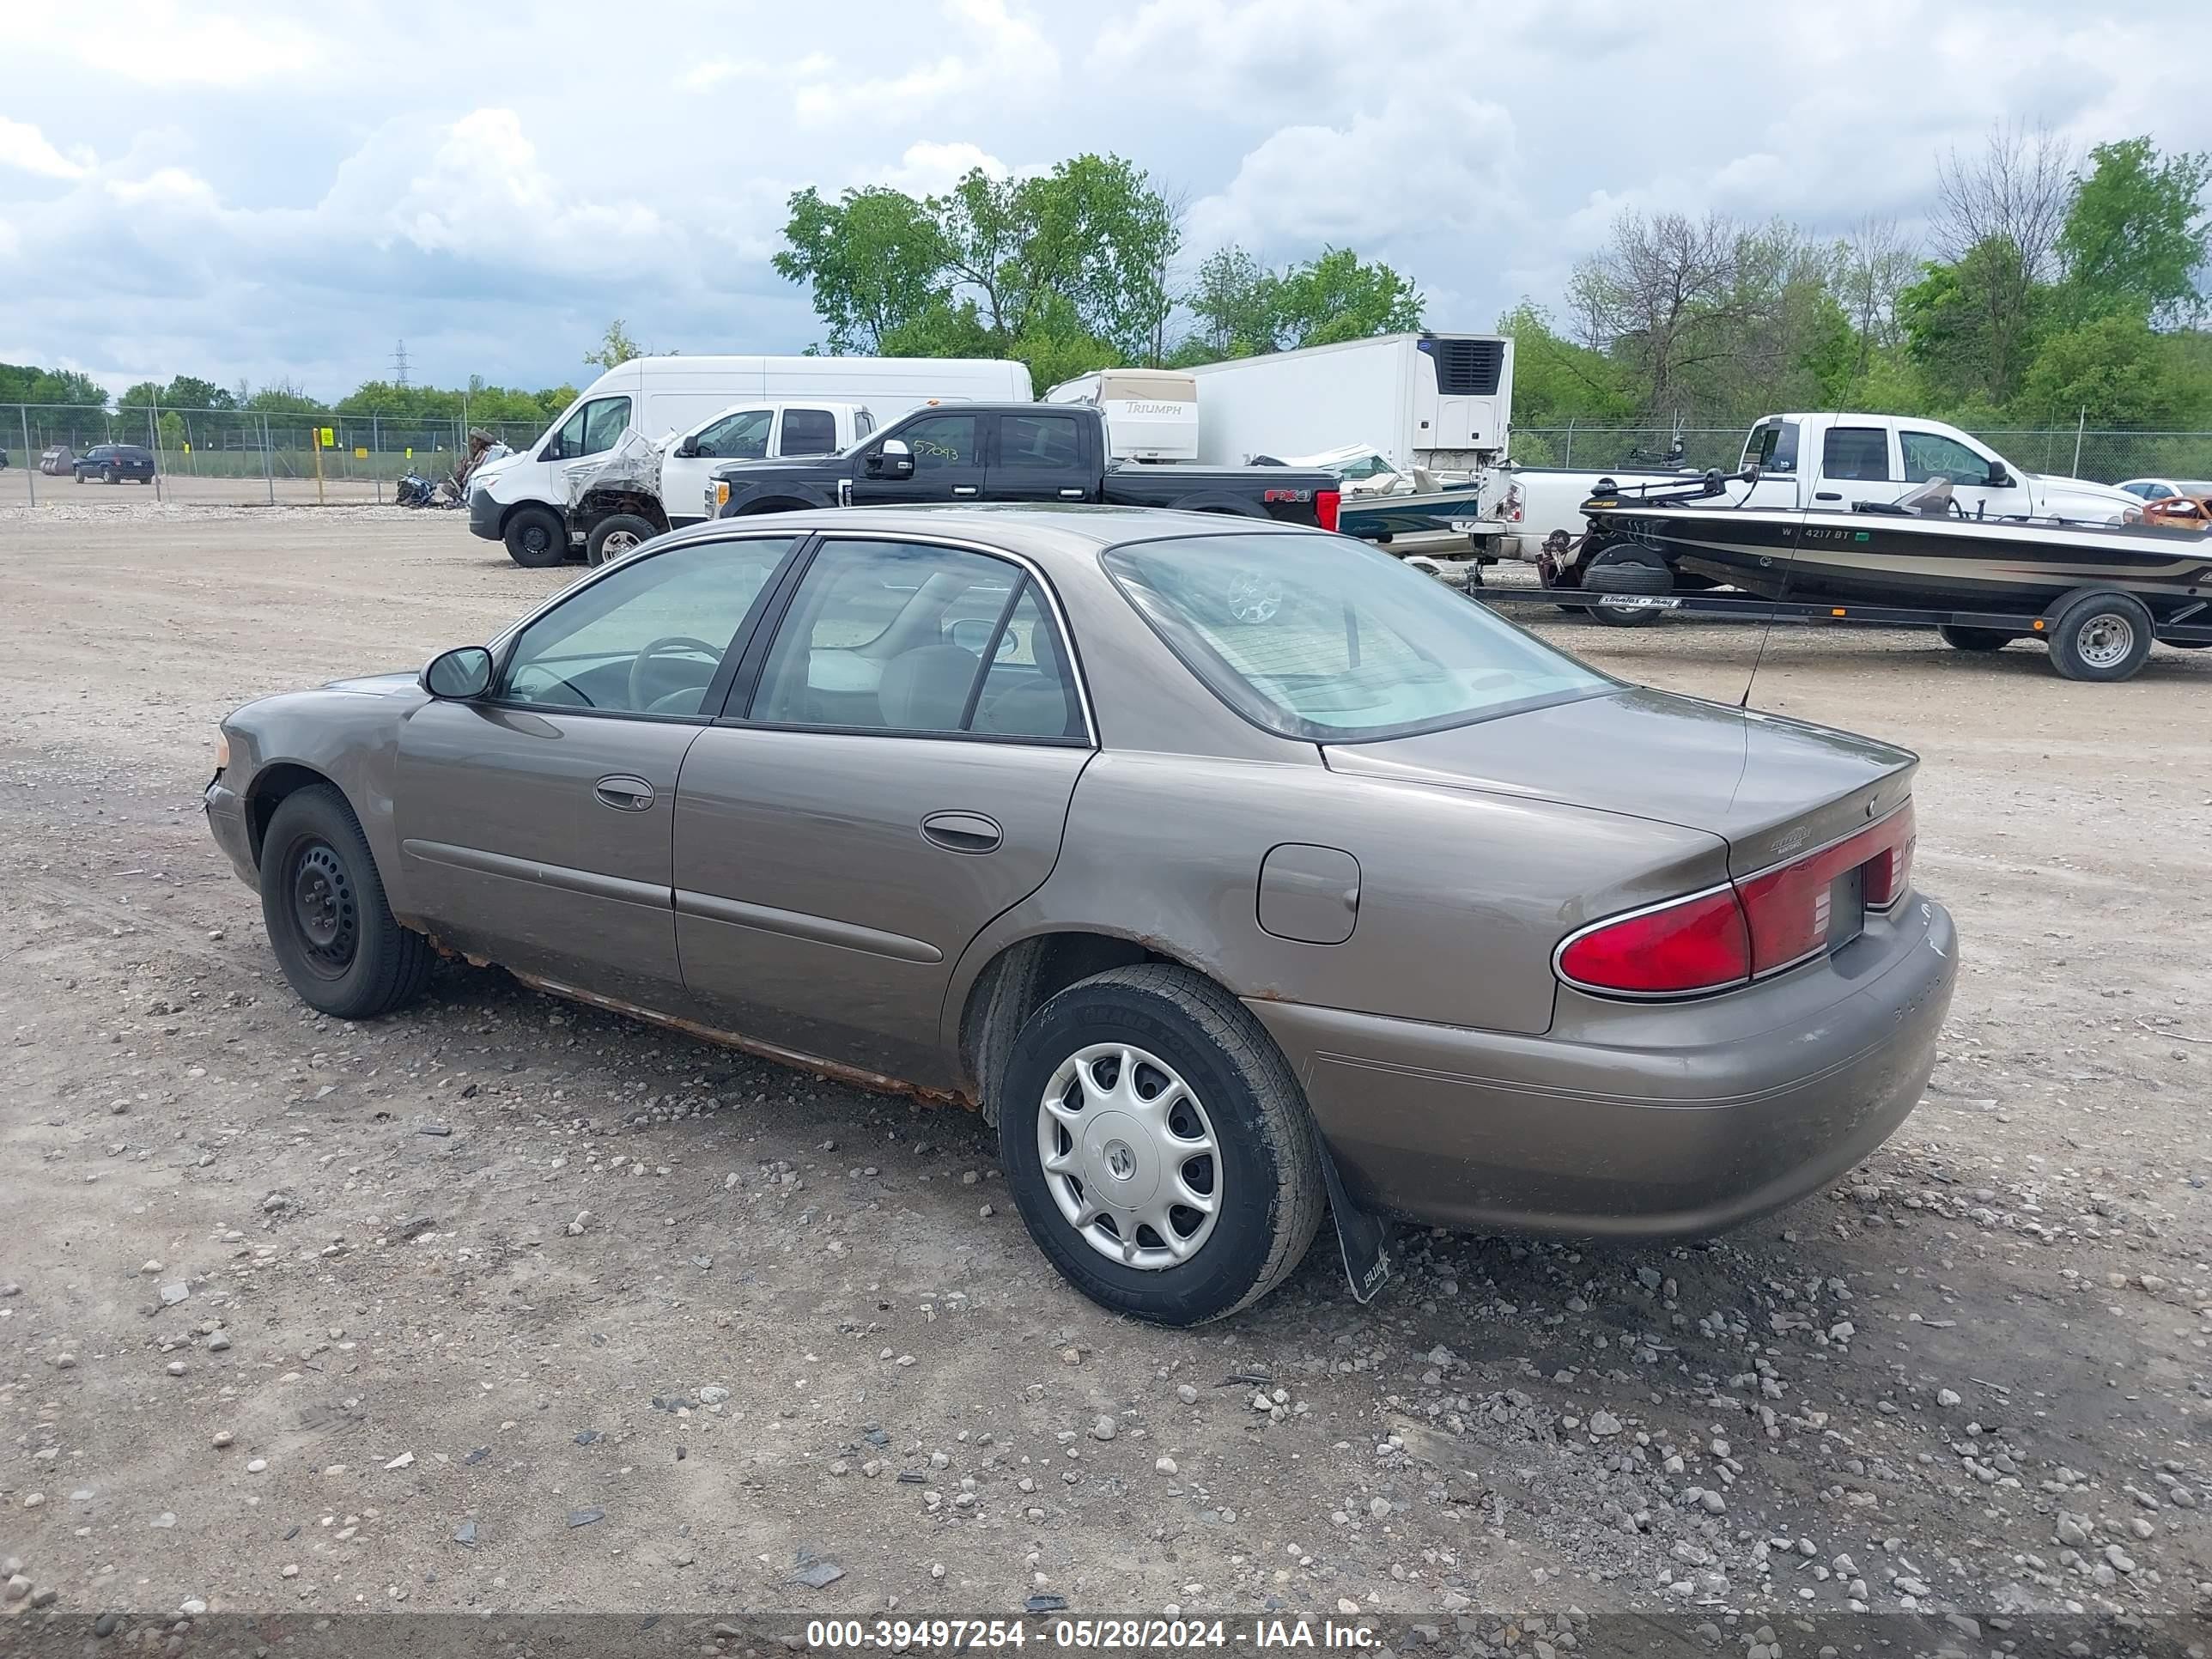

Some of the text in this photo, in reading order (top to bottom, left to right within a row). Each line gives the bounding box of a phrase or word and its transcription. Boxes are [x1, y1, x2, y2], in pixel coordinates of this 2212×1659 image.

[1126, 401, 1182, 415] TRIUMPH
[914, 440, 959, 460] 57093
[1264, 489, 1311, 502] FX4
[1805, 529, 1832, 538] 4217
[1834, 531, 1850, 539] BT
